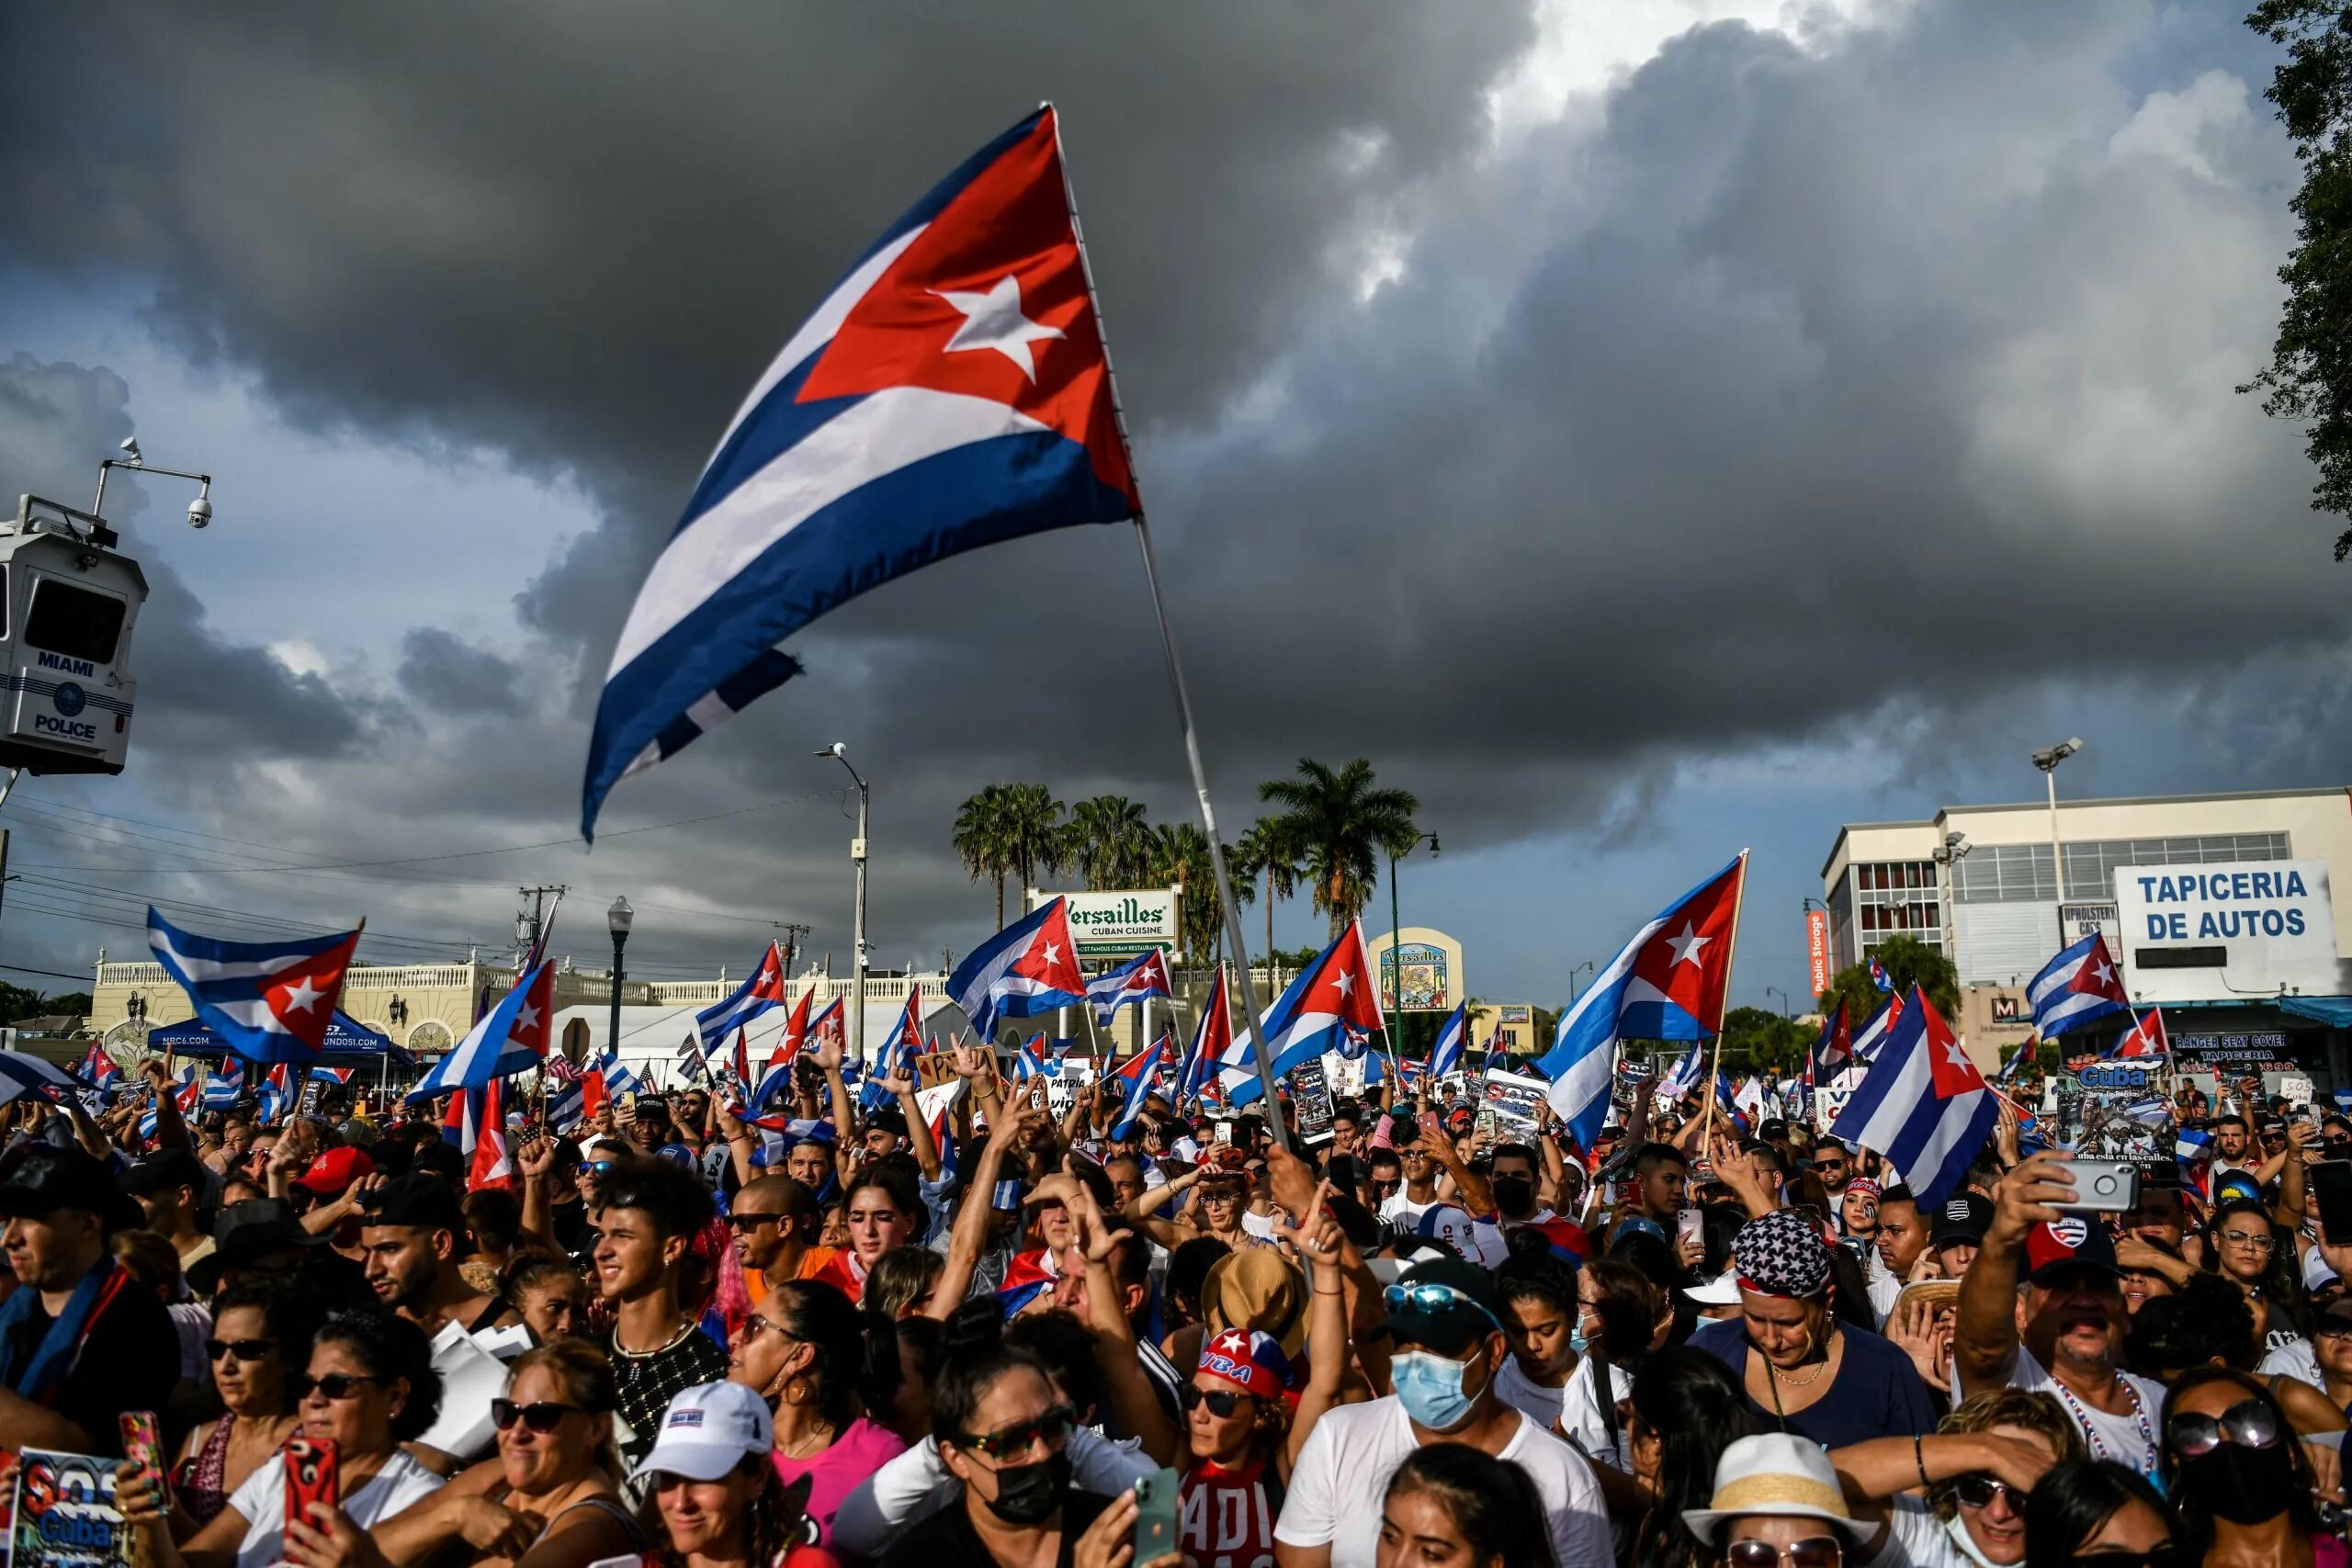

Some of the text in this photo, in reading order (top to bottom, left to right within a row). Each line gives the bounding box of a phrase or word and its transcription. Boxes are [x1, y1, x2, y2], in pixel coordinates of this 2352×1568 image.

[38, 651, 94, 677] MIAMI
[35, 715, 96, 739] POLICE
[2137, 871, 2308, 903] TAPICERIA
[1091, 927, 1124, 935] CUBAN
[2147, 908, 2305, 940] DE AUTOS
[1812, 916, 1824, 992] Public Storage
[323, 1038, 377, 1047] UNDO51.COM
[2176, 1036, 2219, 1048] RANGER
[2222, 1036, 2249, 1048] SEAT
[2200, 1050, 2275, 1061] TAPICERIA
[2079, 1066, 2147, 1087] Cuba
[2072, 1152, 2094, 1160] Cuba
[1199, 1351, 1252, 1384] UBA
[39, 1508, 111, 1548] Cuba
